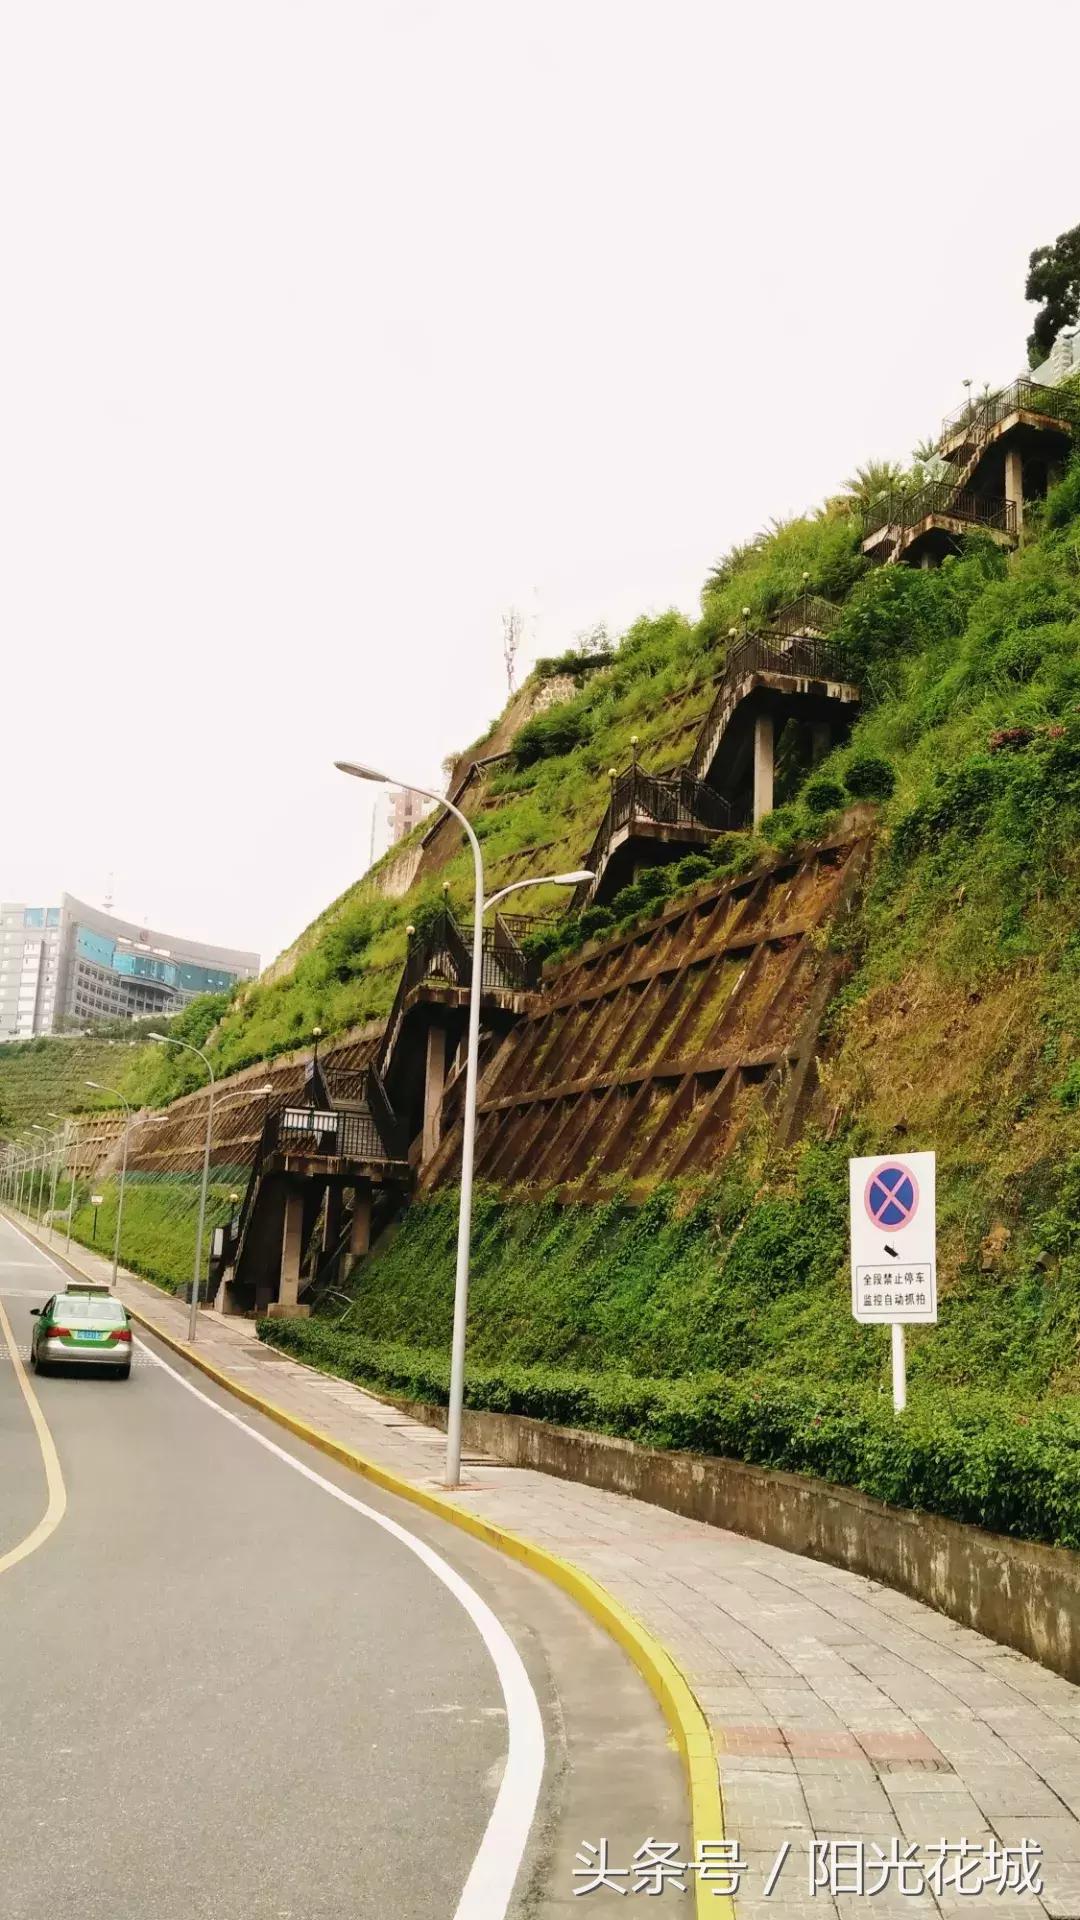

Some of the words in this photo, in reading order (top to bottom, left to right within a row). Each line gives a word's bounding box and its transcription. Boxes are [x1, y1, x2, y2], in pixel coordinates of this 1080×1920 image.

[863, 1271, 925, 1286] 全段禁止停车
[863, 1293, 926, 1306] 监控自动抓拍
